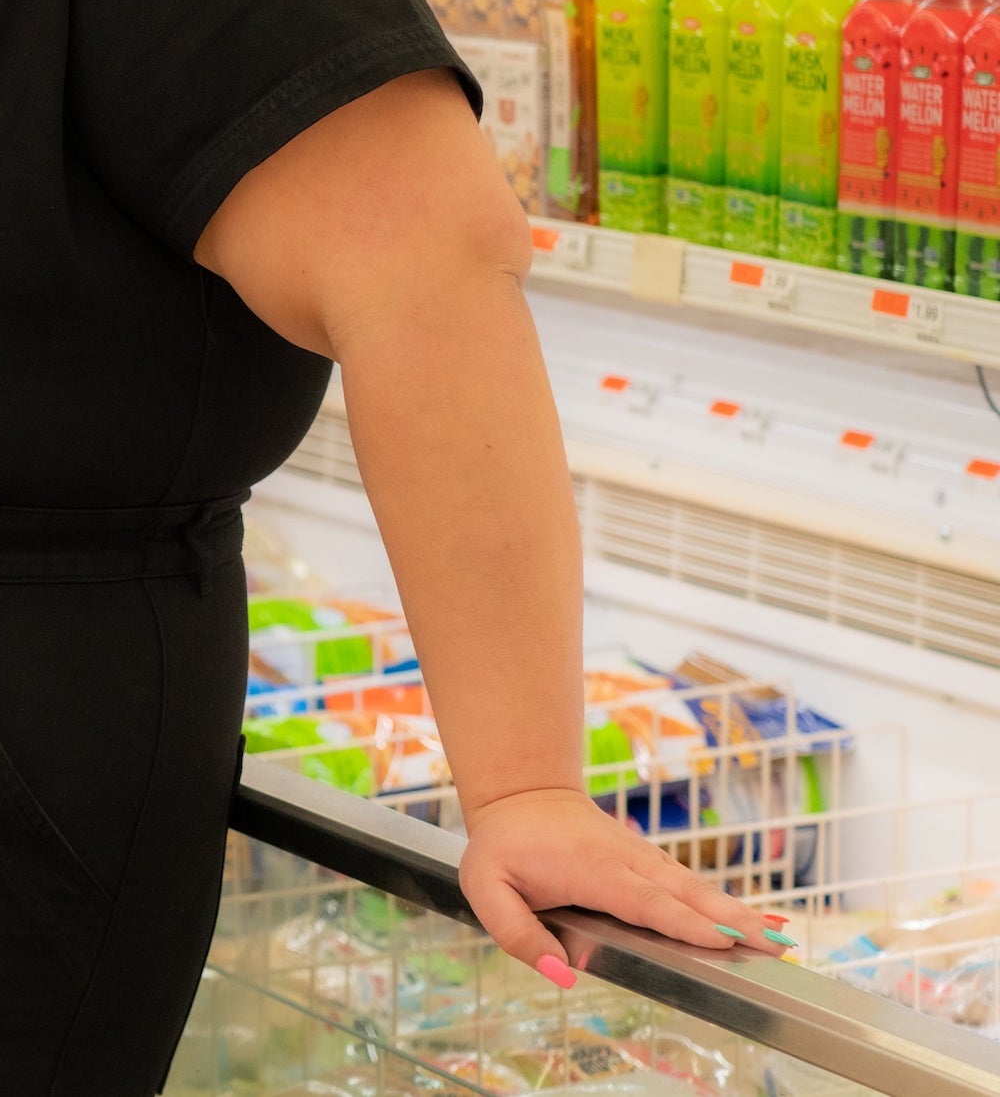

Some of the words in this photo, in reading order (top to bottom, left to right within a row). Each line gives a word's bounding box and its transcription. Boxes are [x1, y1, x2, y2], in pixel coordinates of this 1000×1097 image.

[601, 45, 640, 67] MELON
[673, 53, 710, 75] MELON
[788, 49, 823, 72] MUSK
[728, 58, 764, 81] MELON
[786, 69, 827, 93] MELON
[842, 71, 885, 96] WATER
[900, 79, 943, 105] WATER
[842, 93, 885, 118] MELON
[962, 86, 1000, 113] WATE
[900, 102, 943, 127] MELON
